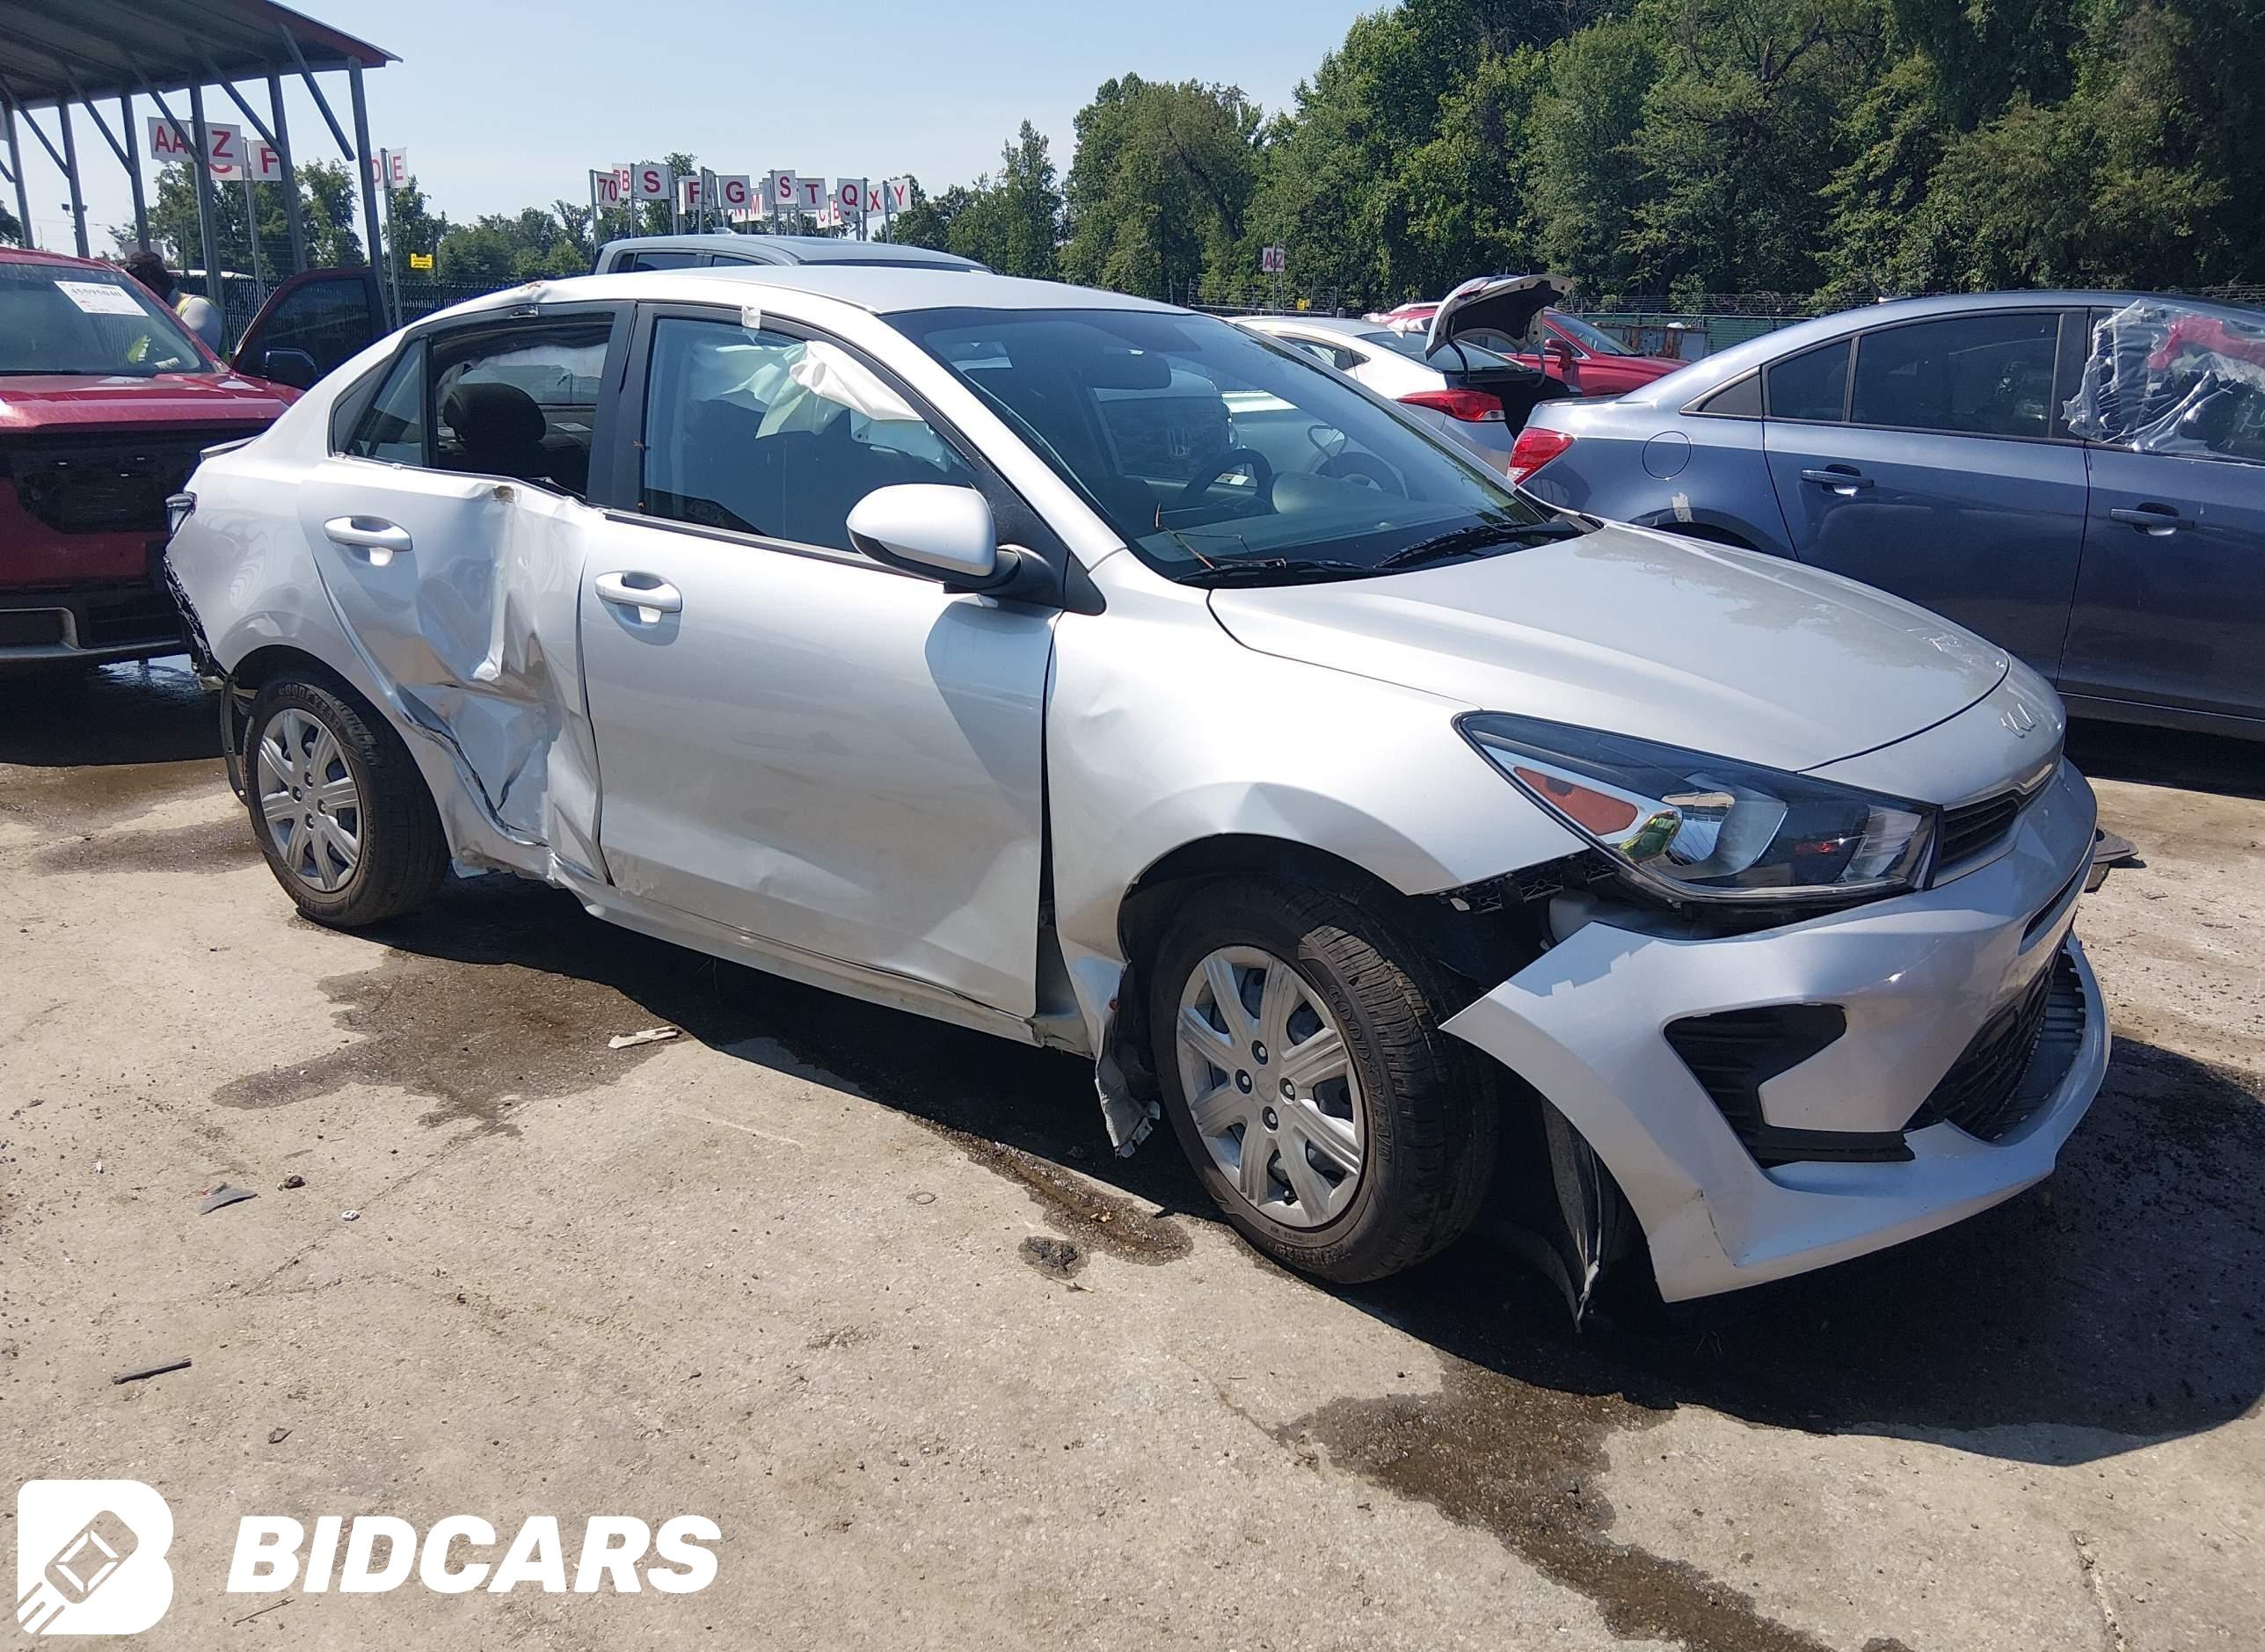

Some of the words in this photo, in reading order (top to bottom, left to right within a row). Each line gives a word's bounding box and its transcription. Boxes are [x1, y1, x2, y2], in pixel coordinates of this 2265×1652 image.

[154, 126, 189, 154] AA
[211, 130, 233, 158] Z
[260, 148, 278, 173] F
[392, 156, 405, 181] E
[599, 178, 618, 202] 70
[644, 171, 660, 193] S
[688, 182, 701, 204] F
[725, 181, 746, 203] G
[779, 176, 791, 198] S
[805, 183, 819, 205] T
[841, 184, 858, 207] Q
[868, 190, 882, 211] X
[893, 185, 905, 206] Y
